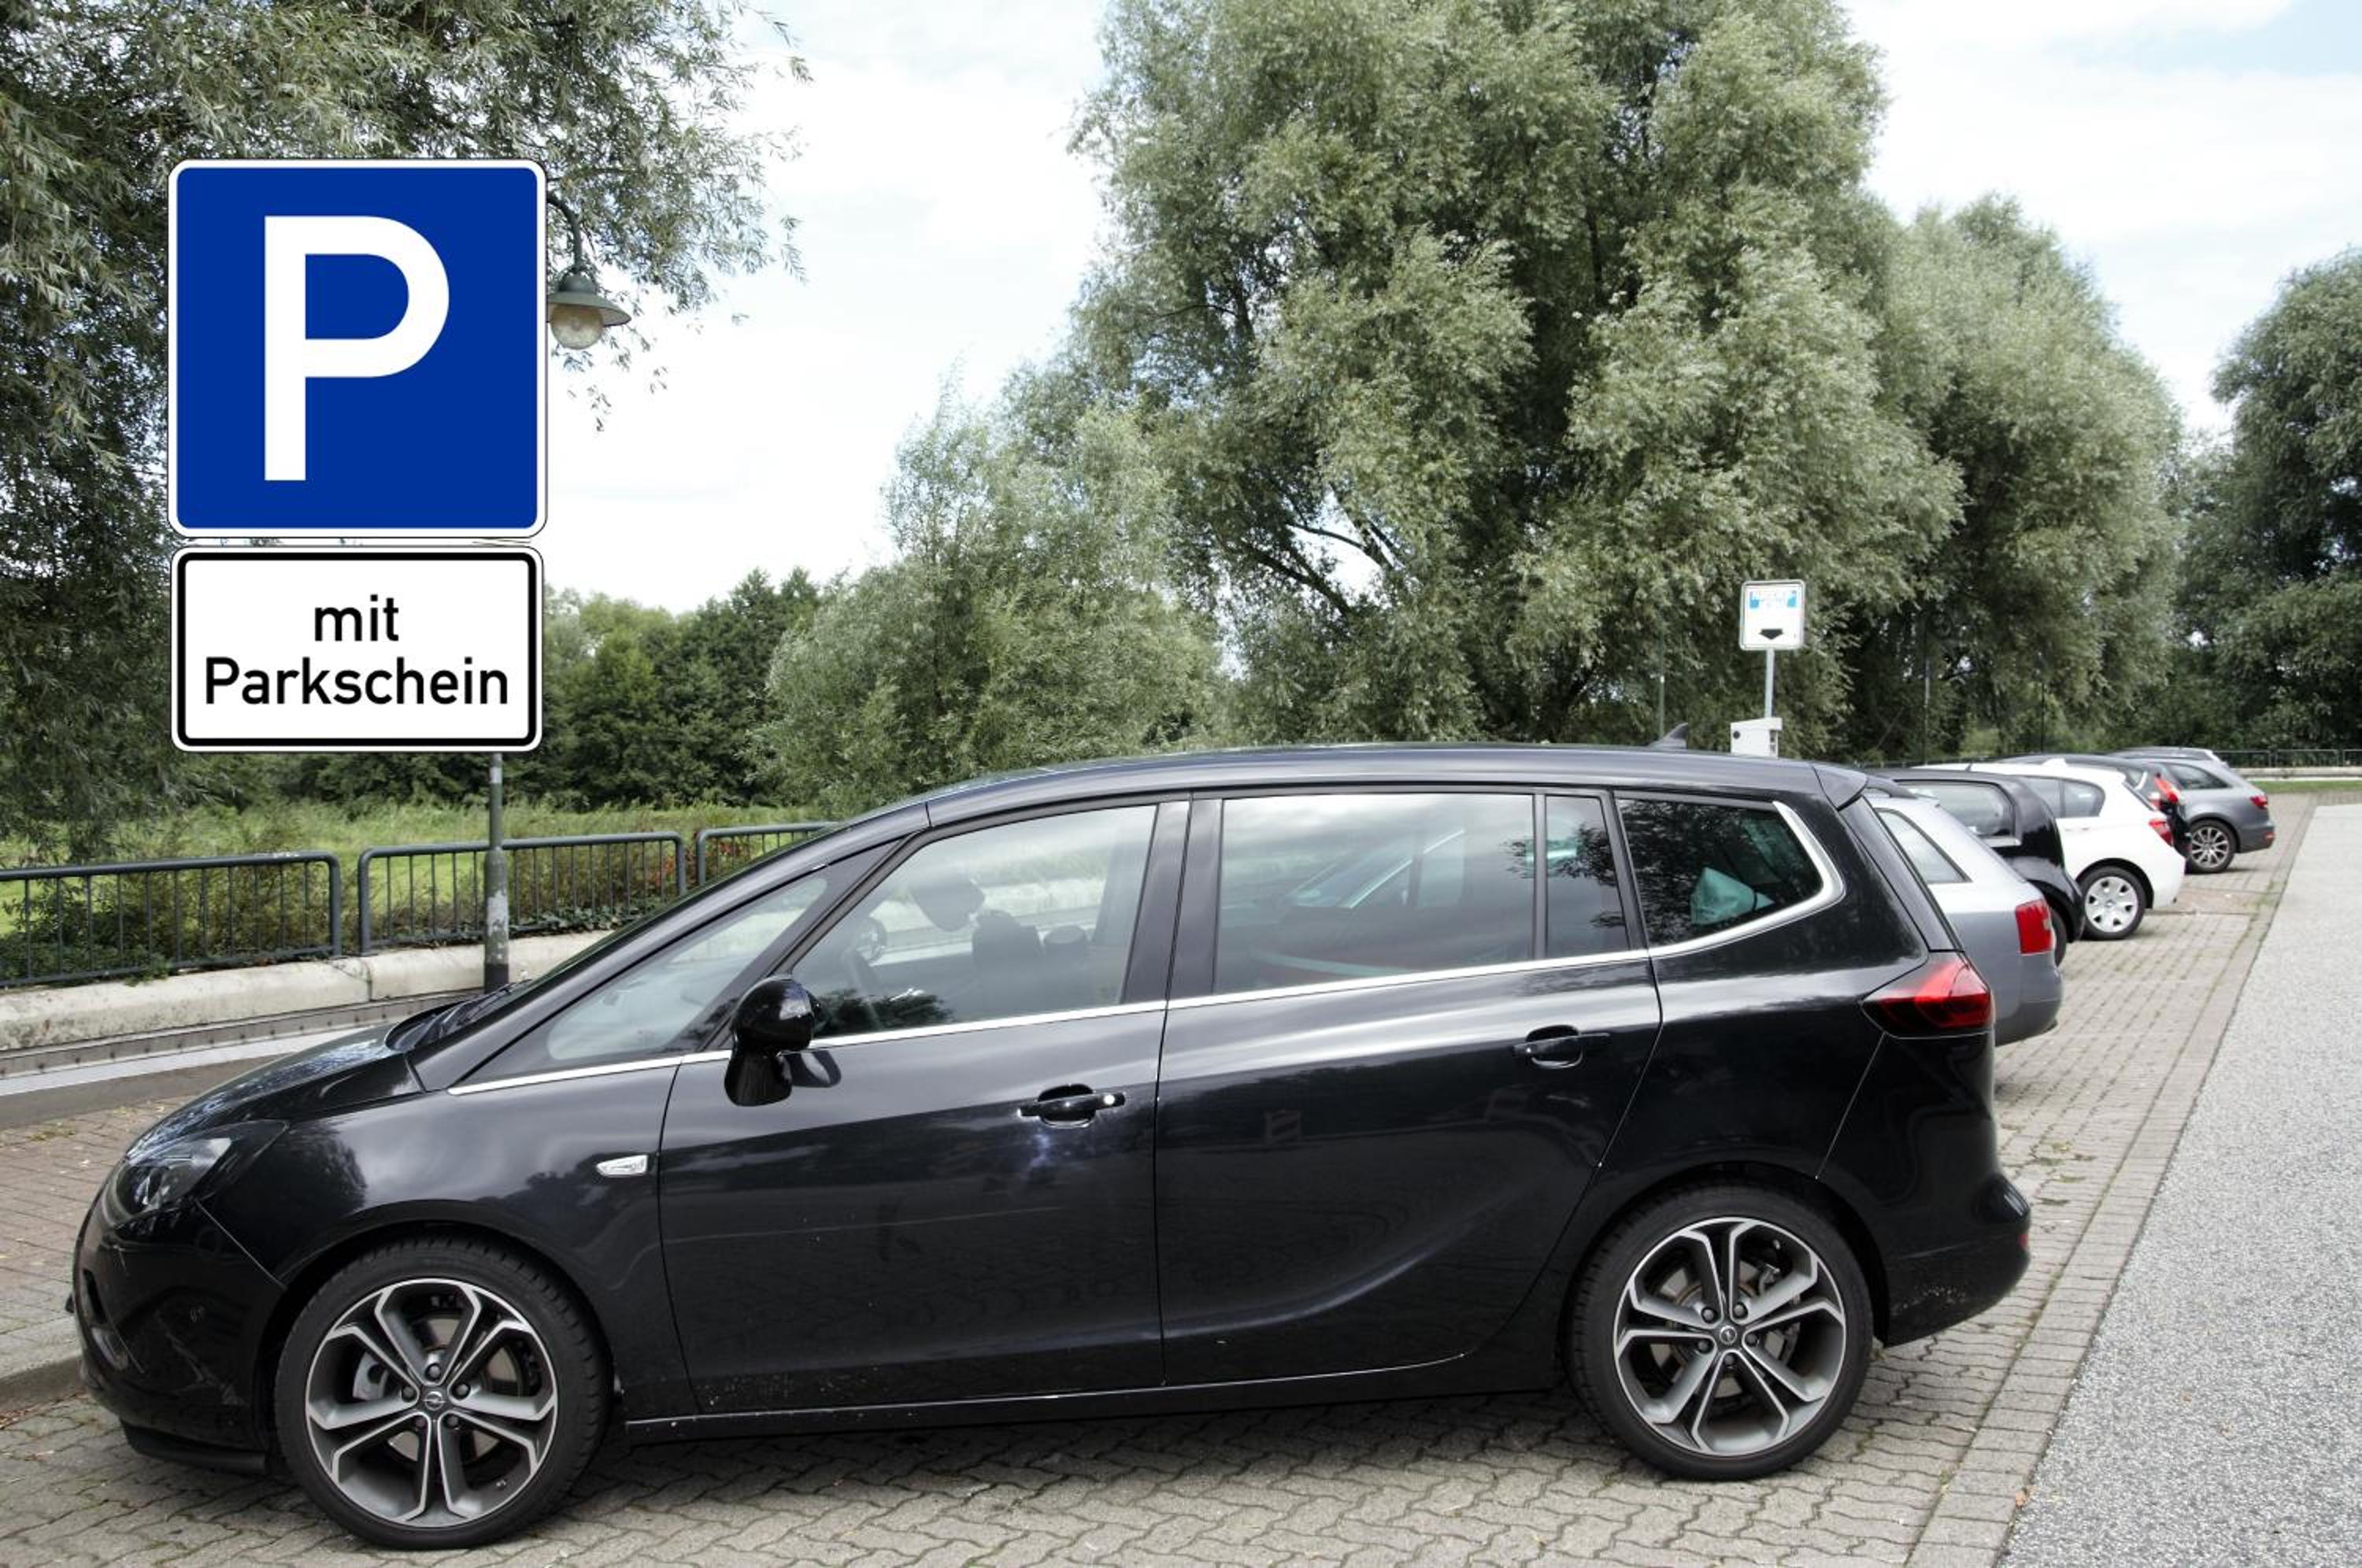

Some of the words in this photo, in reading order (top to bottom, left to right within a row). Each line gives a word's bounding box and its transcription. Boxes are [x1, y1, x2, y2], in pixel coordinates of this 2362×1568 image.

[265, 216, 450, 481] P
[314, 594, 399, 642] mit
[205, 656, 508, 704] Parkschein
